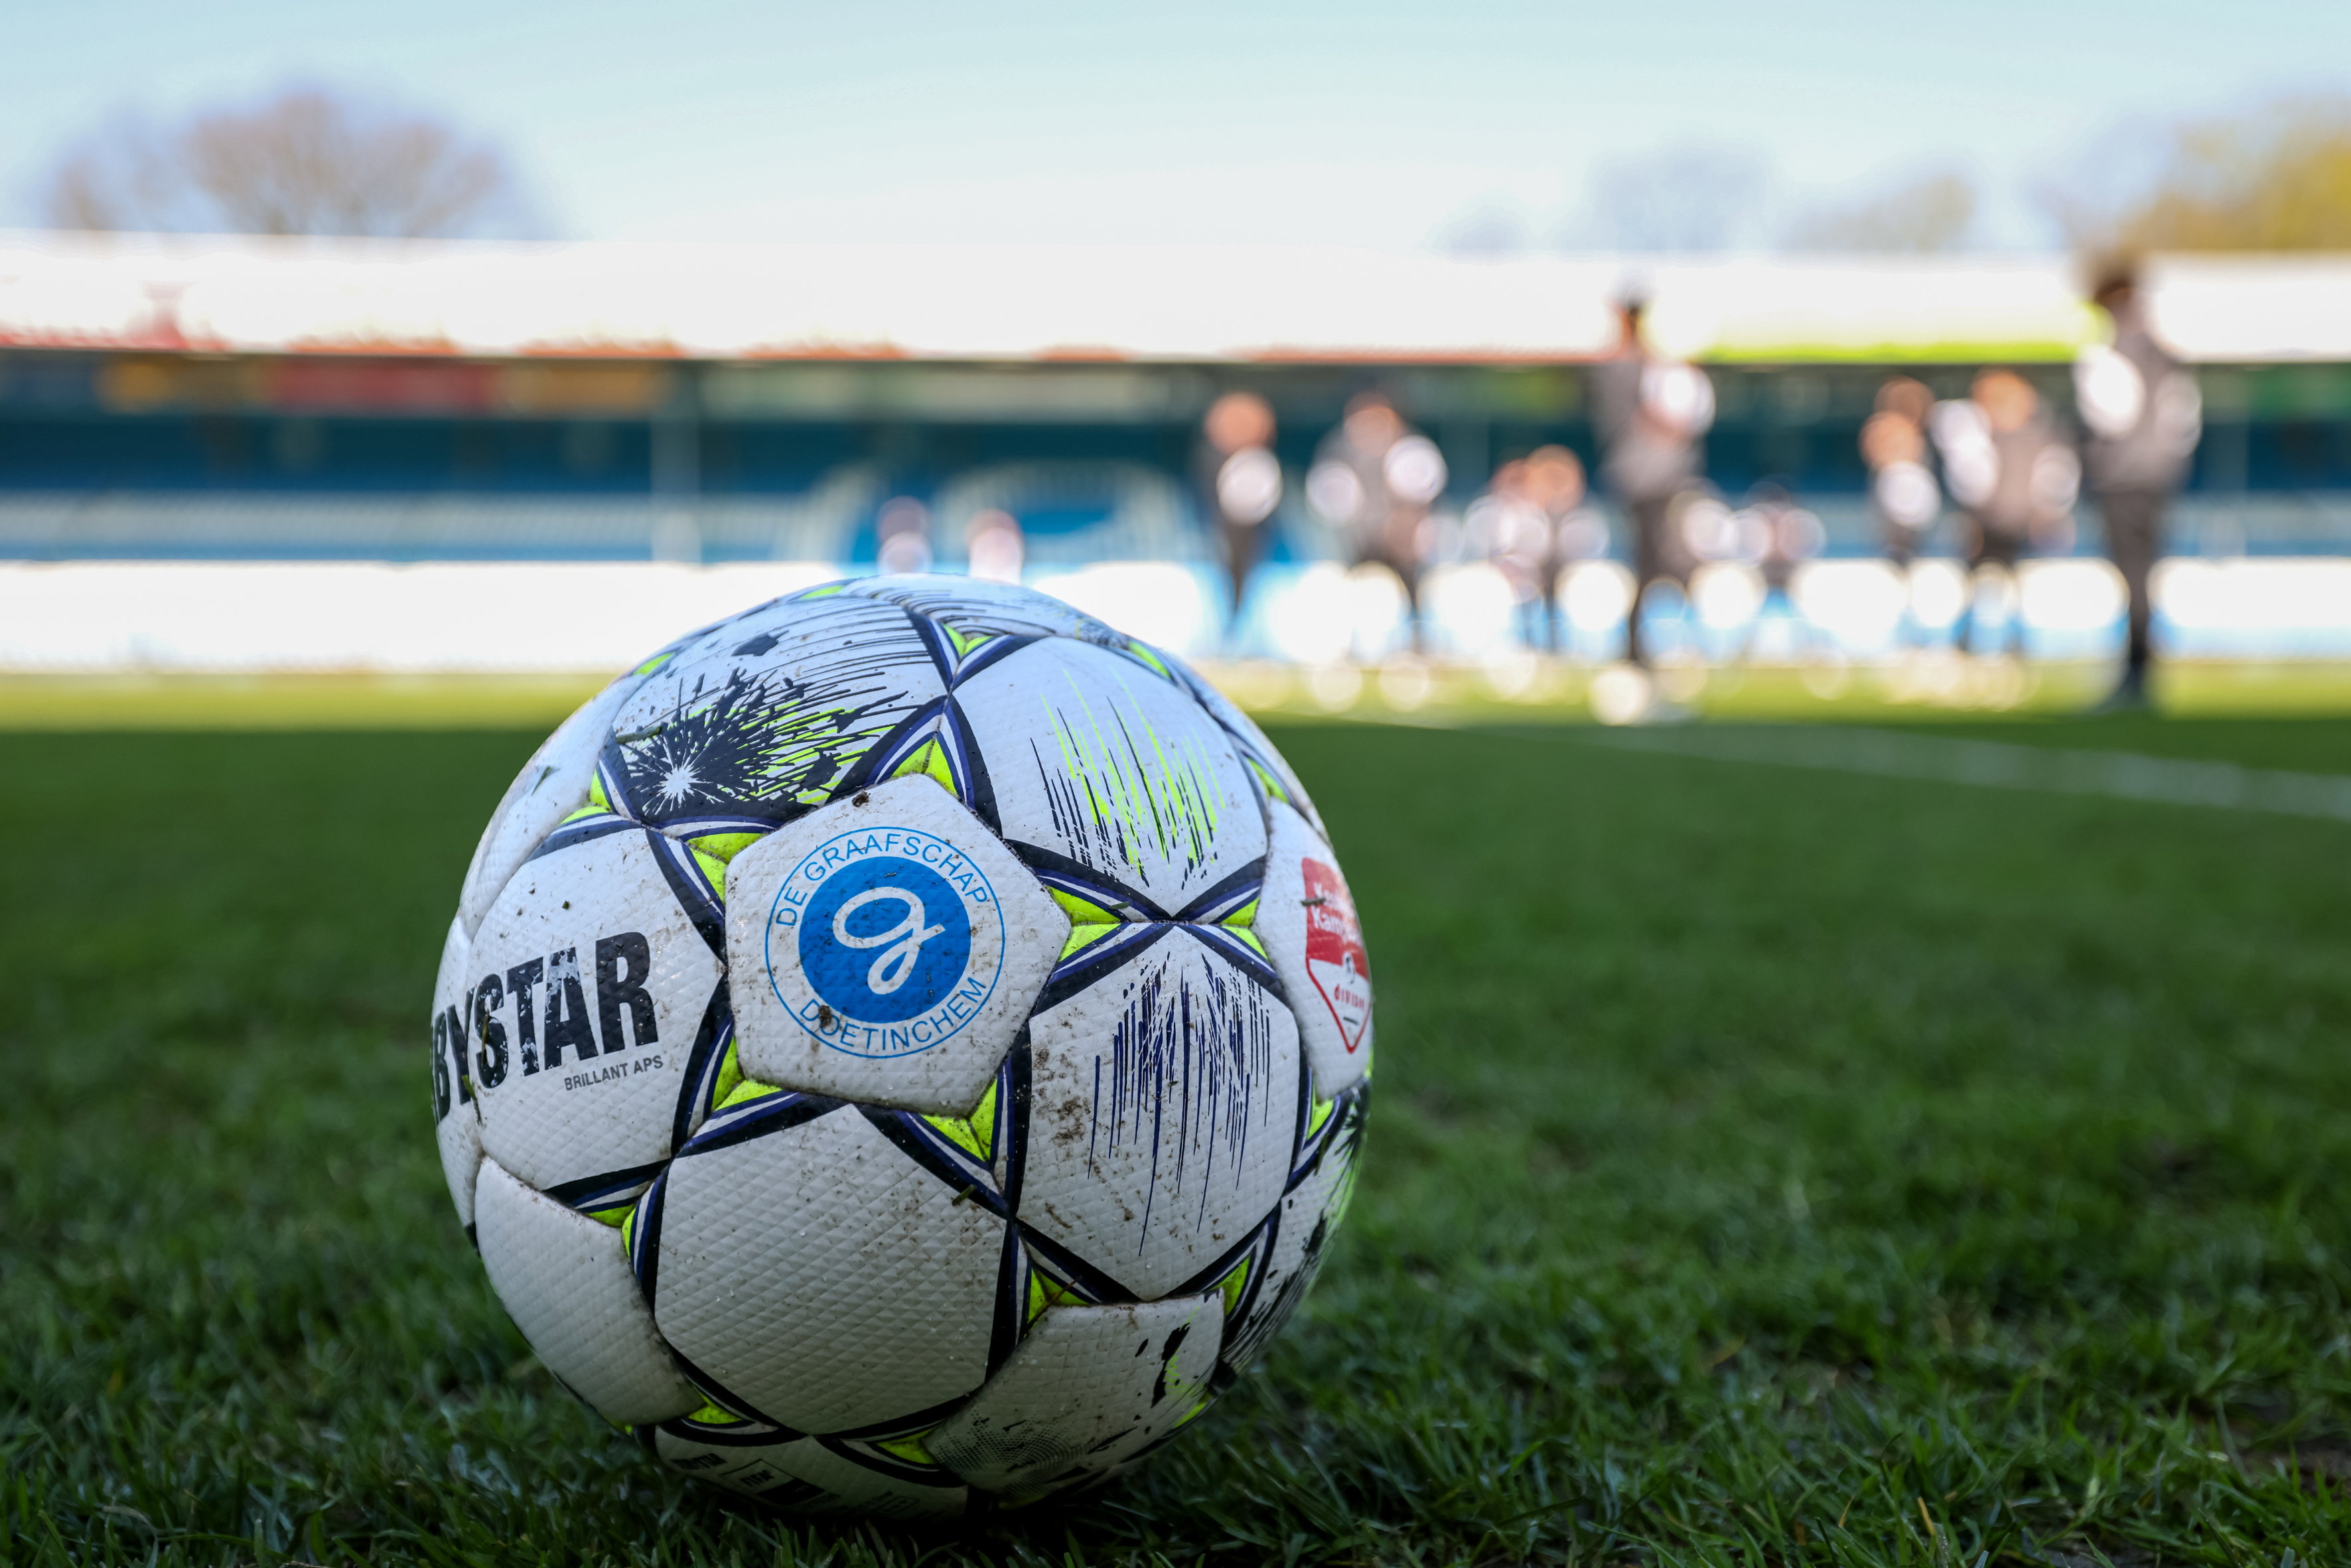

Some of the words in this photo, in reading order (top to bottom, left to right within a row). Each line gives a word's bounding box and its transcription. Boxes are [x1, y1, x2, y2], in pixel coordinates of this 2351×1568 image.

[776, 885, 808, 926] DE
[804, 833, 988, 903] GRAAFSCHAP
[432, 932, 658, 1123] BYSTAR
[799, 977, 986, 1050] DOETINCHEM
[564, 1063, 628, 1090] BRILLANT
[634, 1055, 664, 1074] APS
